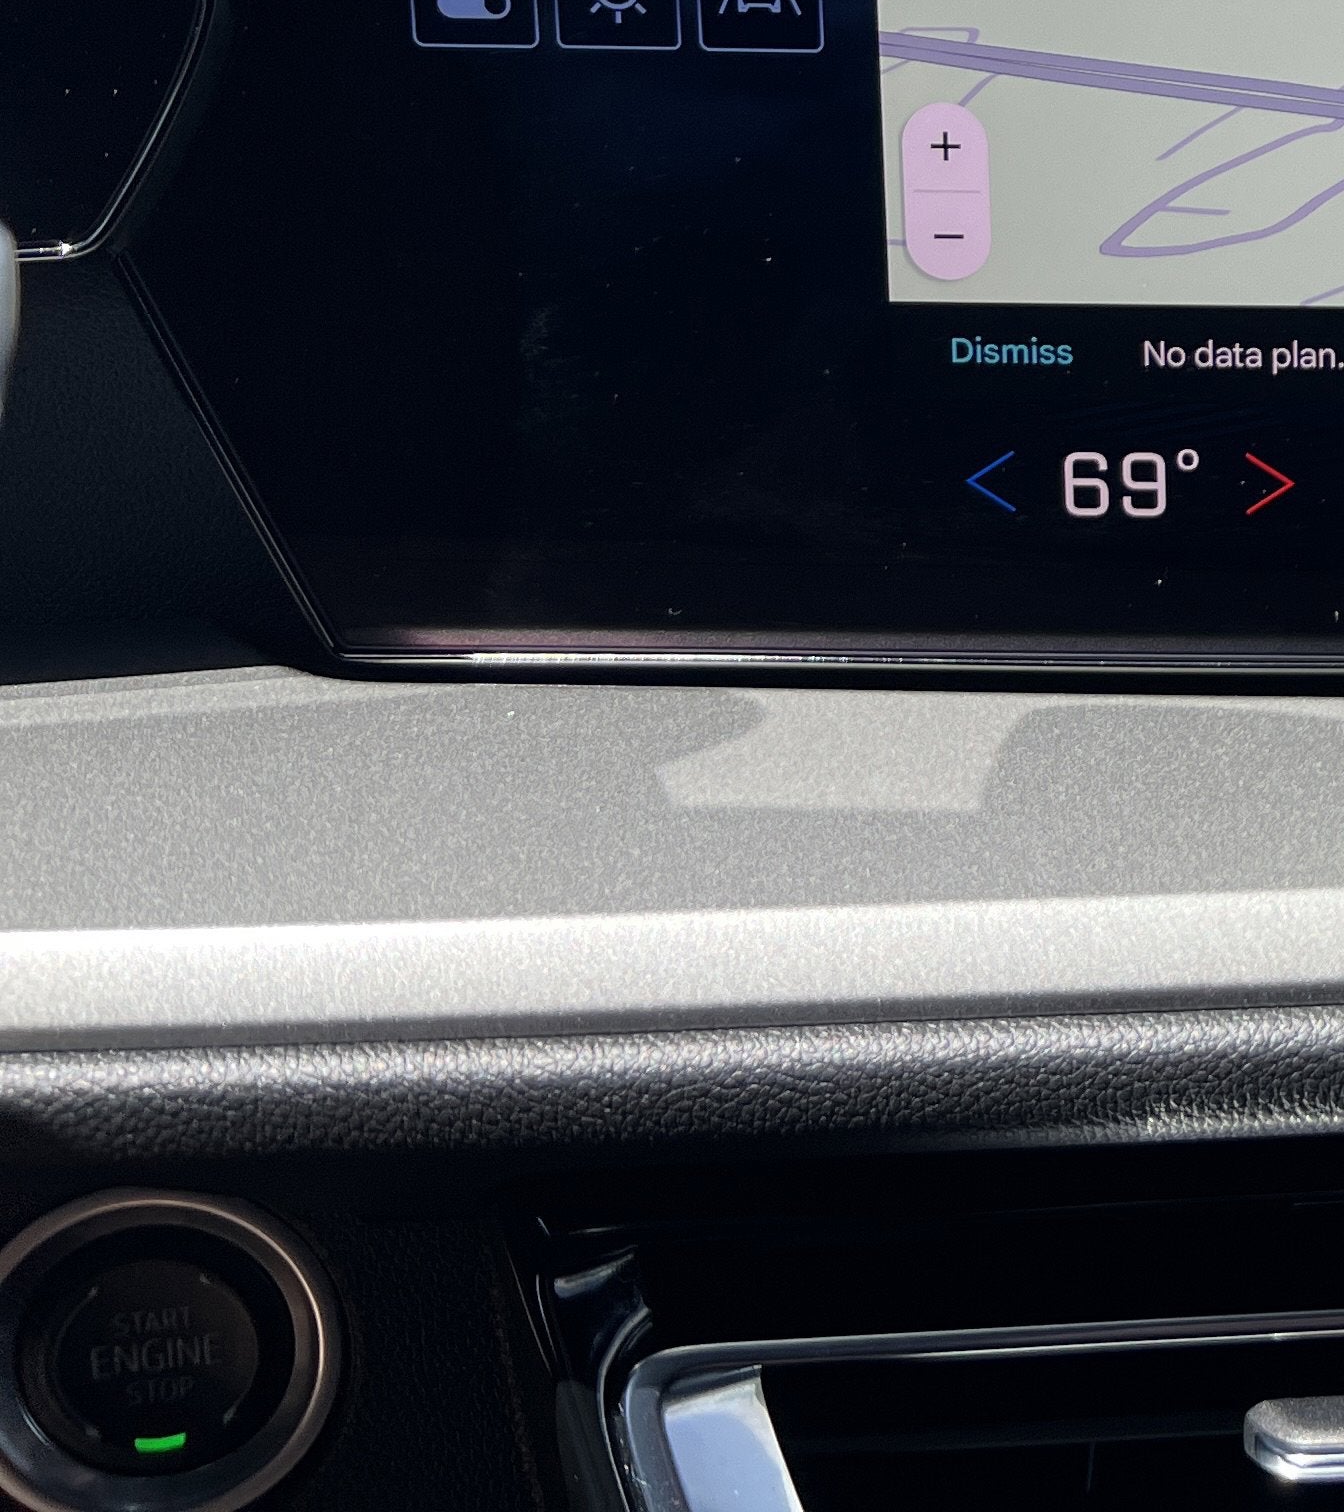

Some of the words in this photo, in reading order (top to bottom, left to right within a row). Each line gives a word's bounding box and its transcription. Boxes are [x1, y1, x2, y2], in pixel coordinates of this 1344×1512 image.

[951, 335, 1074, 366] Dismiss
[1143, 338, 1186, 370] No
[1194, 337, 1263, 370] data
[1271, 338, 1344, 376] plan.
[1061, 448, 1201, 519] 69°
[111, 1305, 190, 1337] START
[90, 1333, 220, 1380] ENGINE
